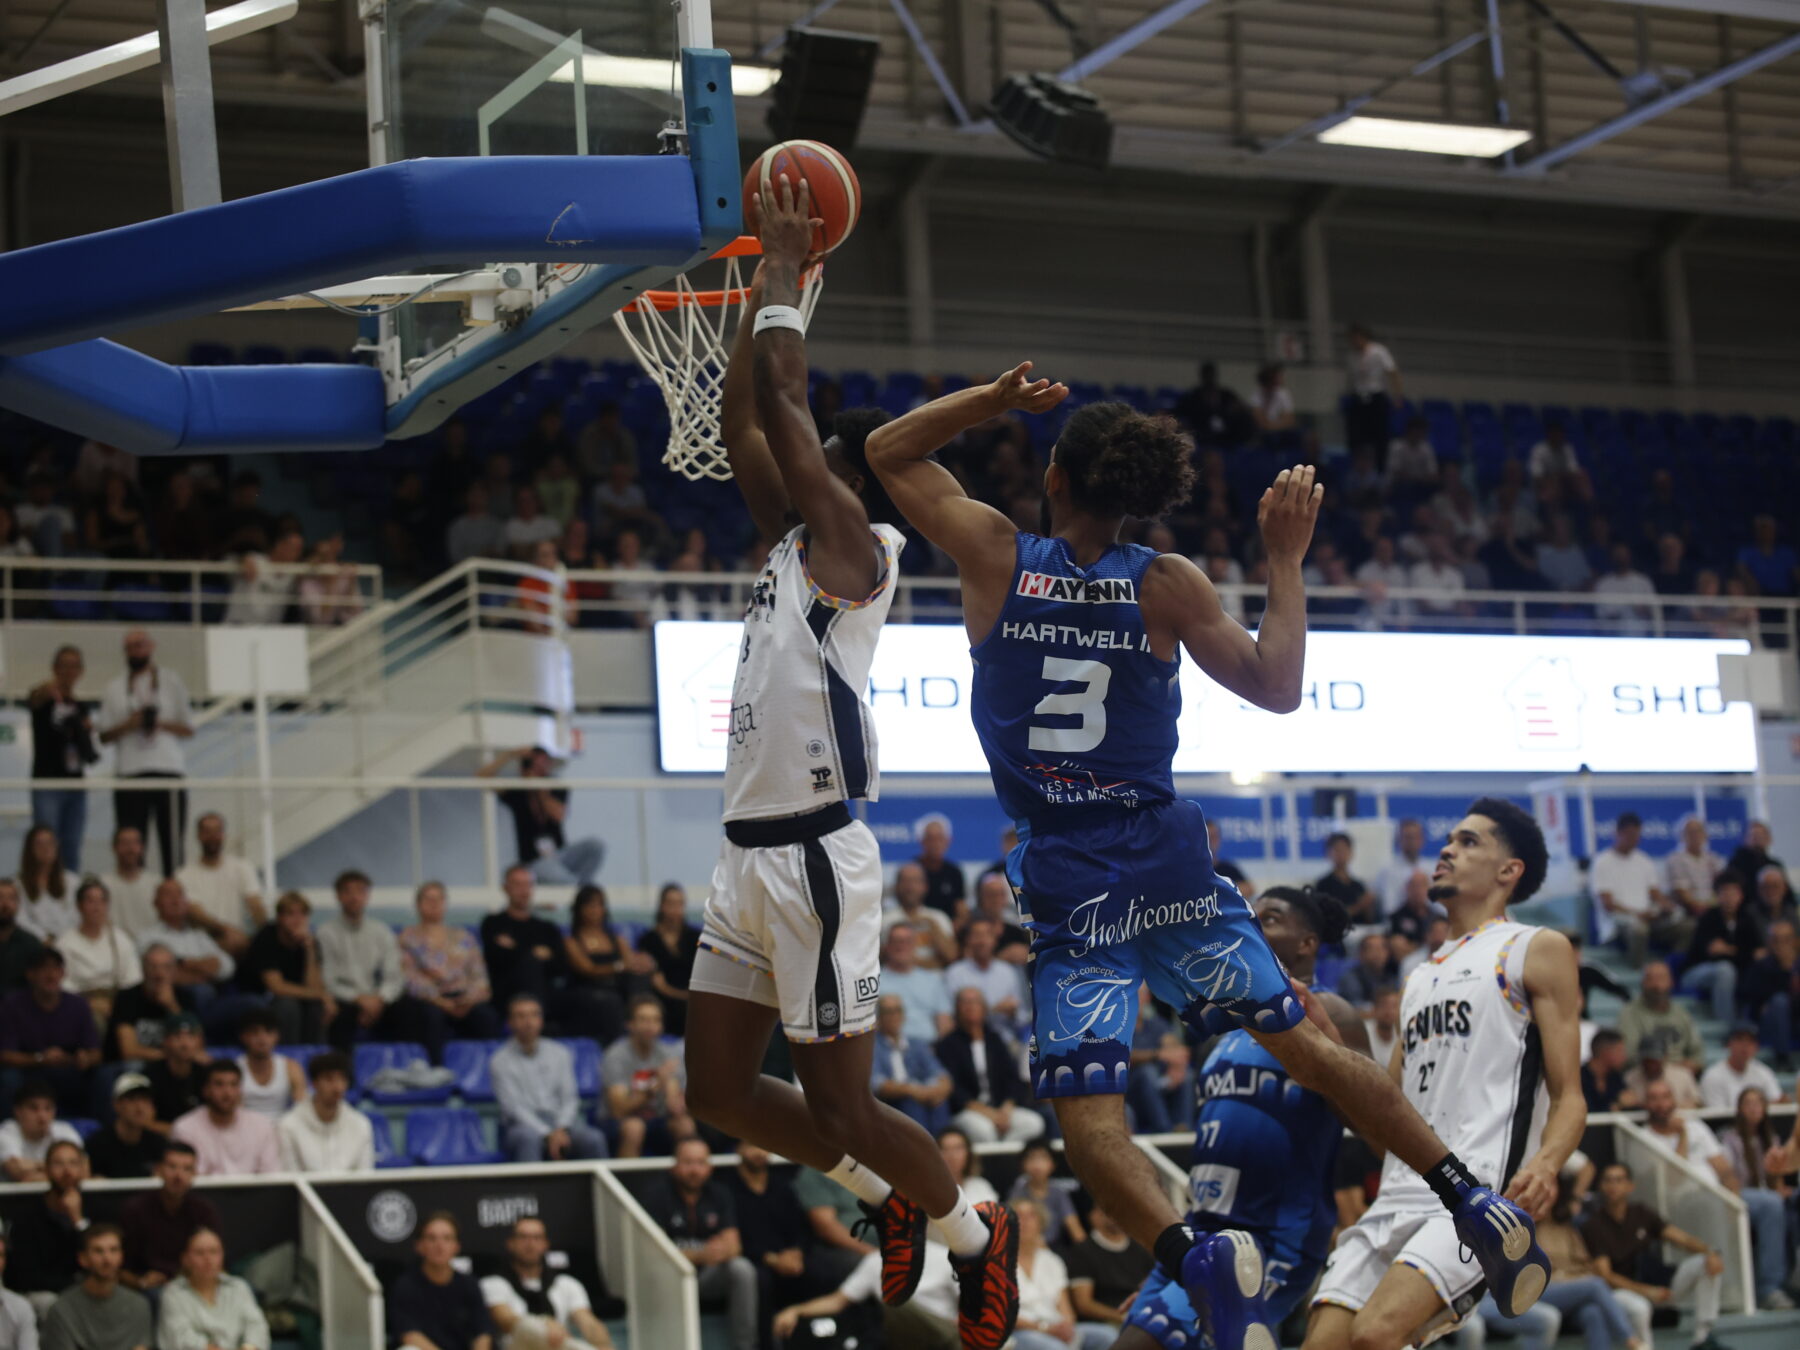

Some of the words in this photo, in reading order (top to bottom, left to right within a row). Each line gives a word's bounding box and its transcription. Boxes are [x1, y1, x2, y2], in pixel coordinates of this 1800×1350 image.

[1003, 621, 1133, 650] HARTWELL
[868, 677, 959, 708] HD
[1028, 656, 1112, 753] 3
[1612, 684, 1727, 714] SHD
[1047, 793, 1063, 804] DE
[1067, 791, 1084, 803] LA
[1056, 966, 1115, 990] Festi-concept
[1402, 998, 1472, 1058] ENNES
